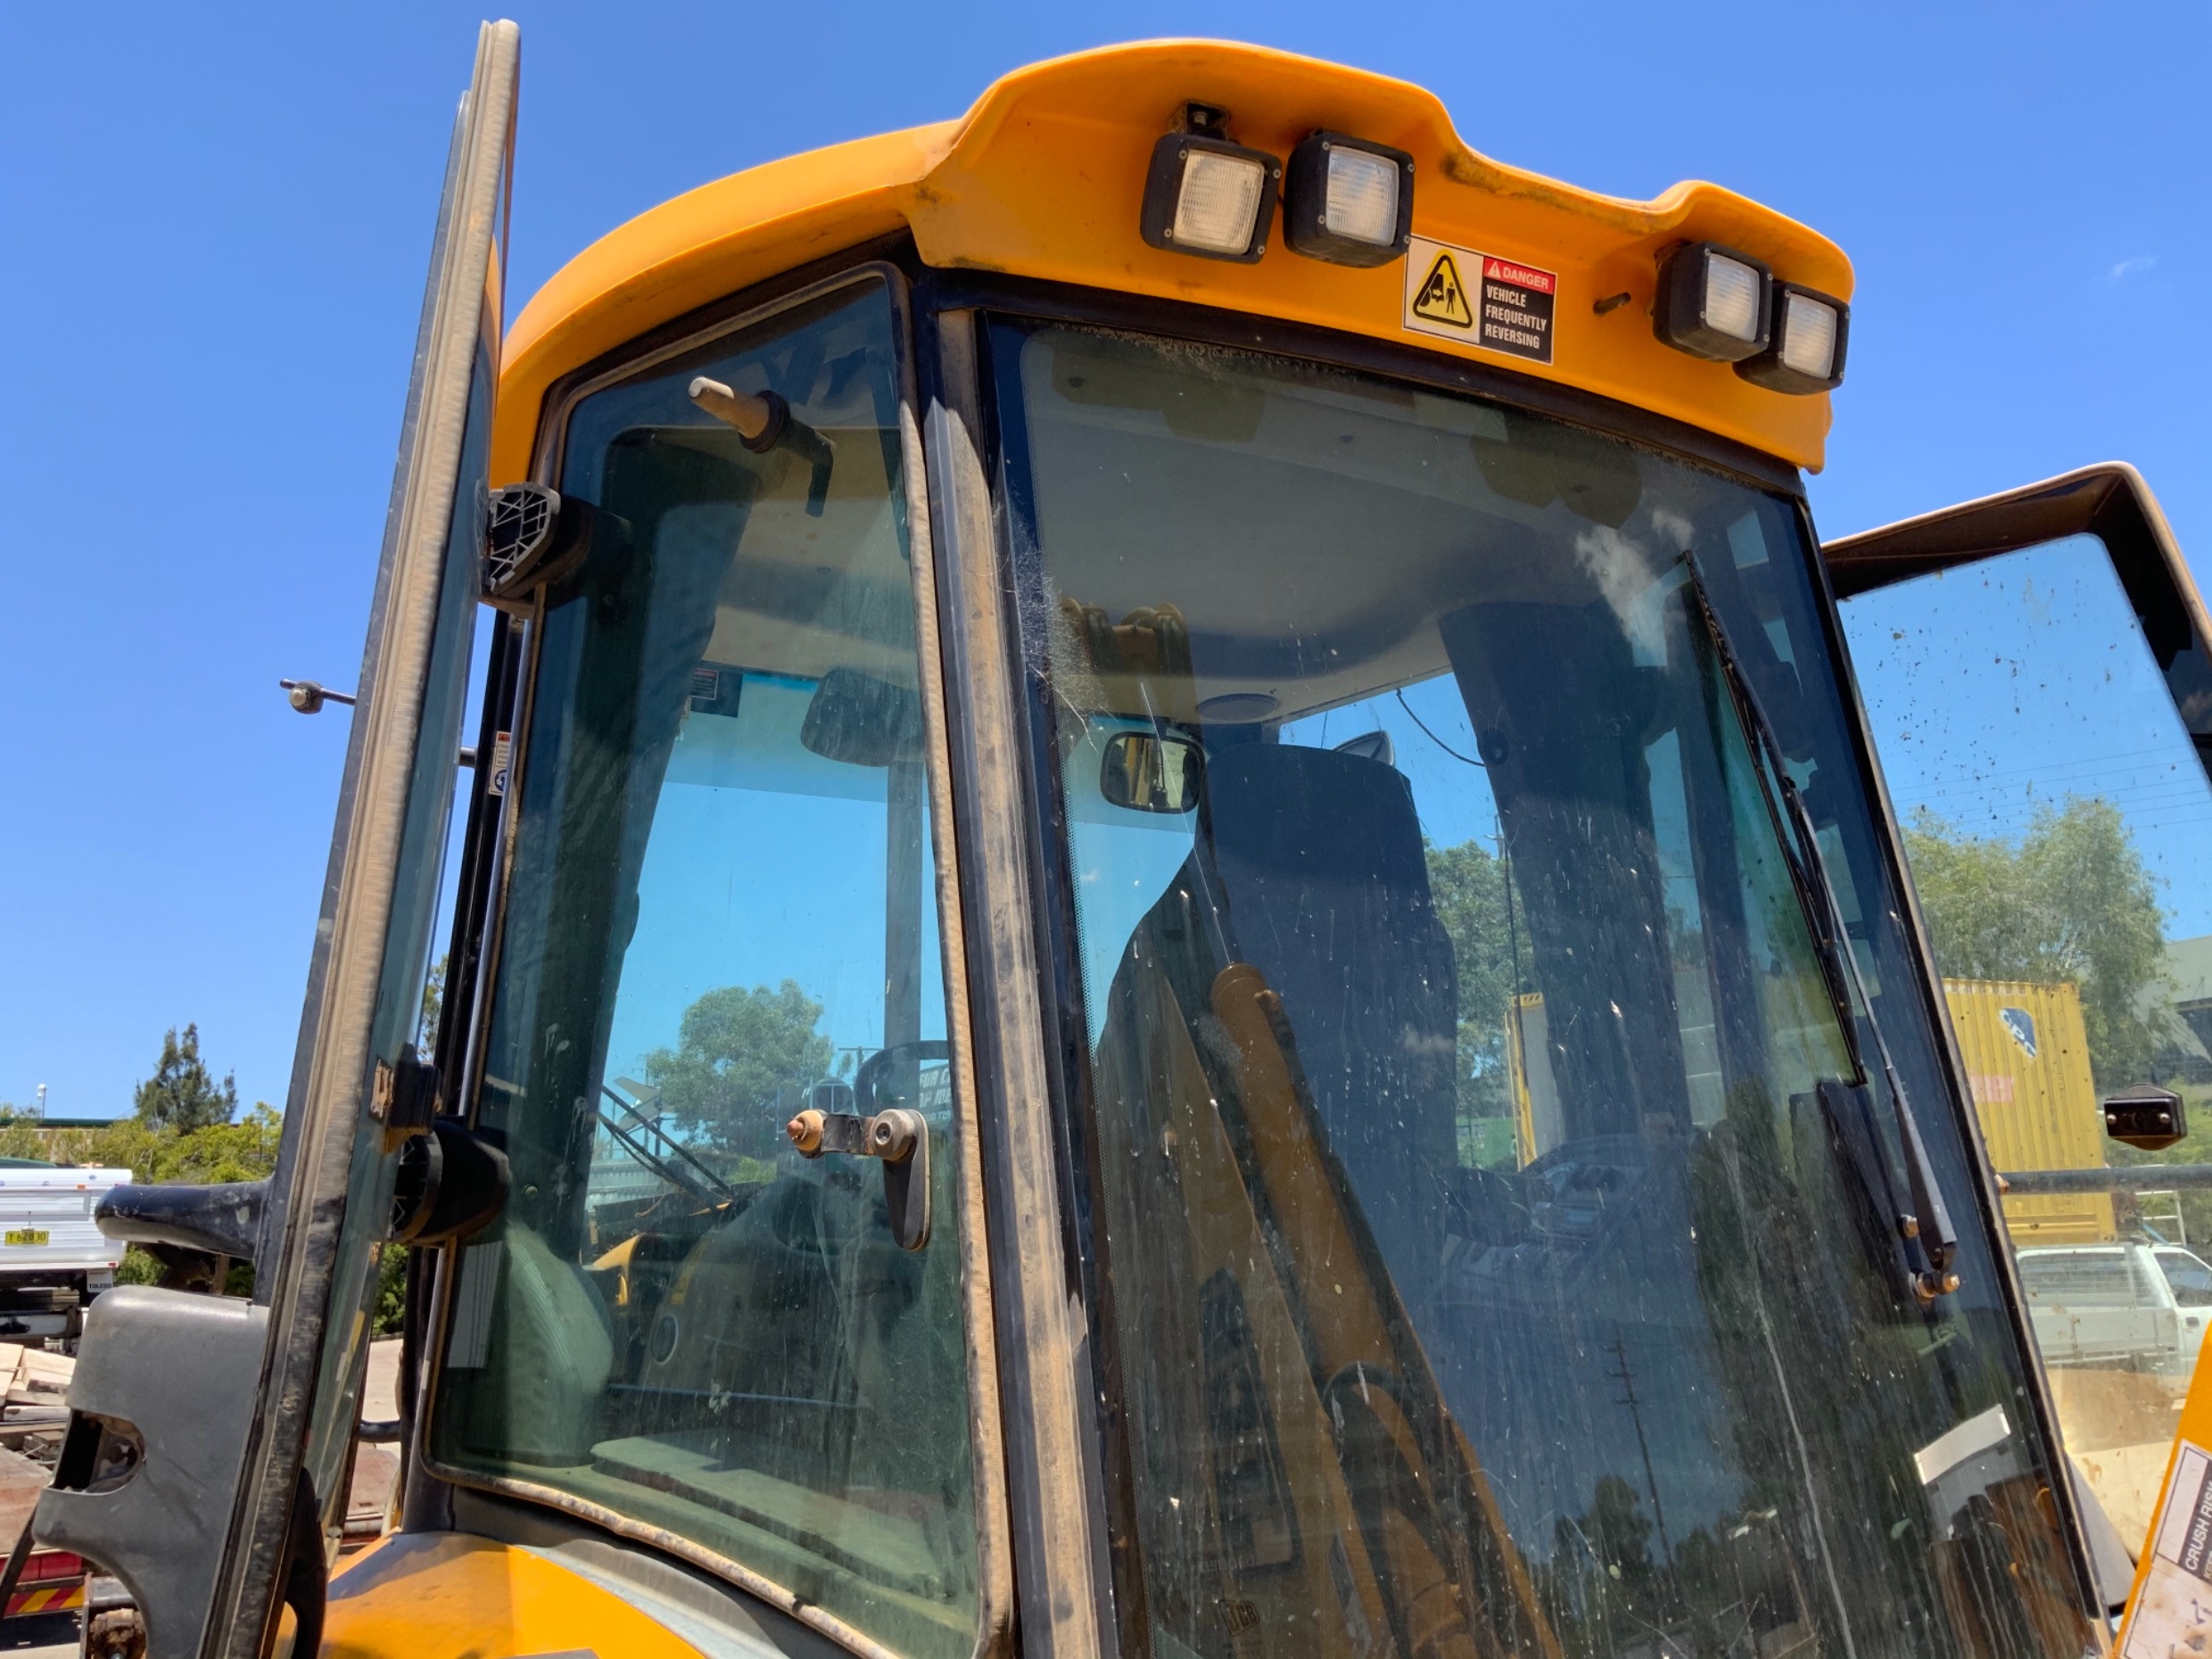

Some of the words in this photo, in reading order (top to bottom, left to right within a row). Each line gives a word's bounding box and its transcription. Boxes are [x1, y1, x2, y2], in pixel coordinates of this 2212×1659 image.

[1502, 267, 1549, 290] DANGER
[1486, 285, 1527, 308] VEHICLE
[1485, 304, 1548, 332] FREQUENTLY
[1485, 323, 1540, 349] REVERSING
[2185, 1517, 2212, 1571] CRUSH
[1224, 1602, 1259, 1632] JCB
